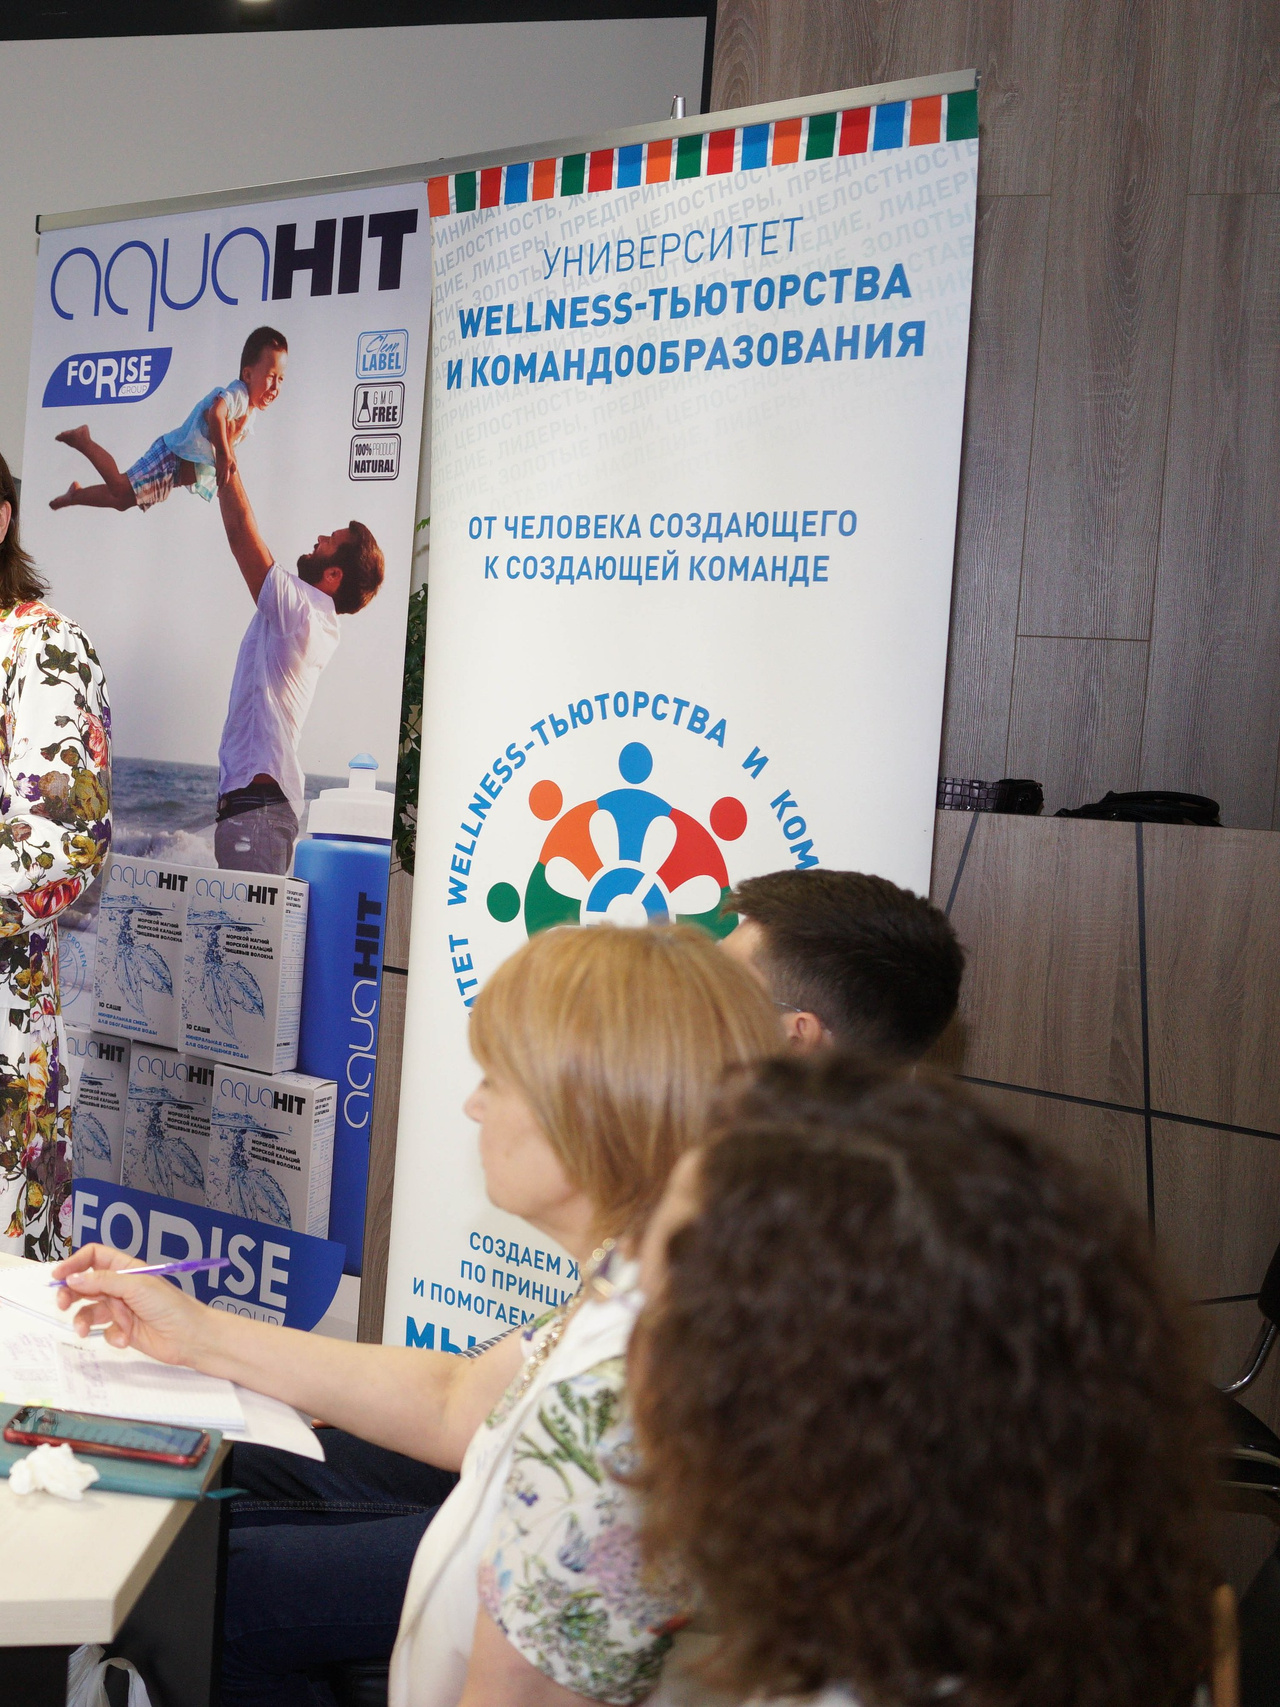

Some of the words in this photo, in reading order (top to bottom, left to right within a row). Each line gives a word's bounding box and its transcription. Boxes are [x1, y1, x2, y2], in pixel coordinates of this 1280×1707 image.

[544, 216, 803, 279] УНИВЕРСИТЕТ
[50, 209, 418, 332] aquaHIT
[459, 263, 911, 339] WELLNESS-ТЬЮТОРСТВА
[362, 352, 401, 372] LABEL
[365, 334, 400, 353] Clean
[447, 355, 463, 390] И
[476, 320, 926, 386] КОМАНДООБРАЗОВАНИЯ
[67, 355, 152, 398] FORISE
[121, 385, 147, 395] GROUP
[372, 405, 398, 423] FREE
[354, 459, 395, 473] NATURAL
[355, 443, 372, 456] 100%
[372, 441, 397, 456] PRODUCT
[469, 516, 496, 540] ОТ
[504, 514, 642, 540] ЧЕЛОВЕКА
[649, 510, 858, 543] СОЗДАЮЩЕГО
[484, 556, 499, 580] К
[506, 550, 679, 586] СОЗДАЮЩЕЙ
[689, 554, 830, 587] КОМАНДЕ
[447, 691, 728, 906] WELLNESS-ТЬЮТОРСТВА
[741, 746, 770, 779] И
[110, 864, 188, 892] aquaHIT
[195, 878, 278, 906] aquaHIT
[66, 932, 88, 967] PROVEN
[343, 891, 383, 1129] aquaHIT
[221, 1079, 306, 1116] aquaHIT
[72, 1190, 290, 1309] FORISE
[470, 1231, 560, 1276] СОЗДАЕМ
[413, 1277, 424, 1296] И
[460, 1260, 486, 1283] ПО
[492, 1270, 574, 1308] ПРИНЦИ
